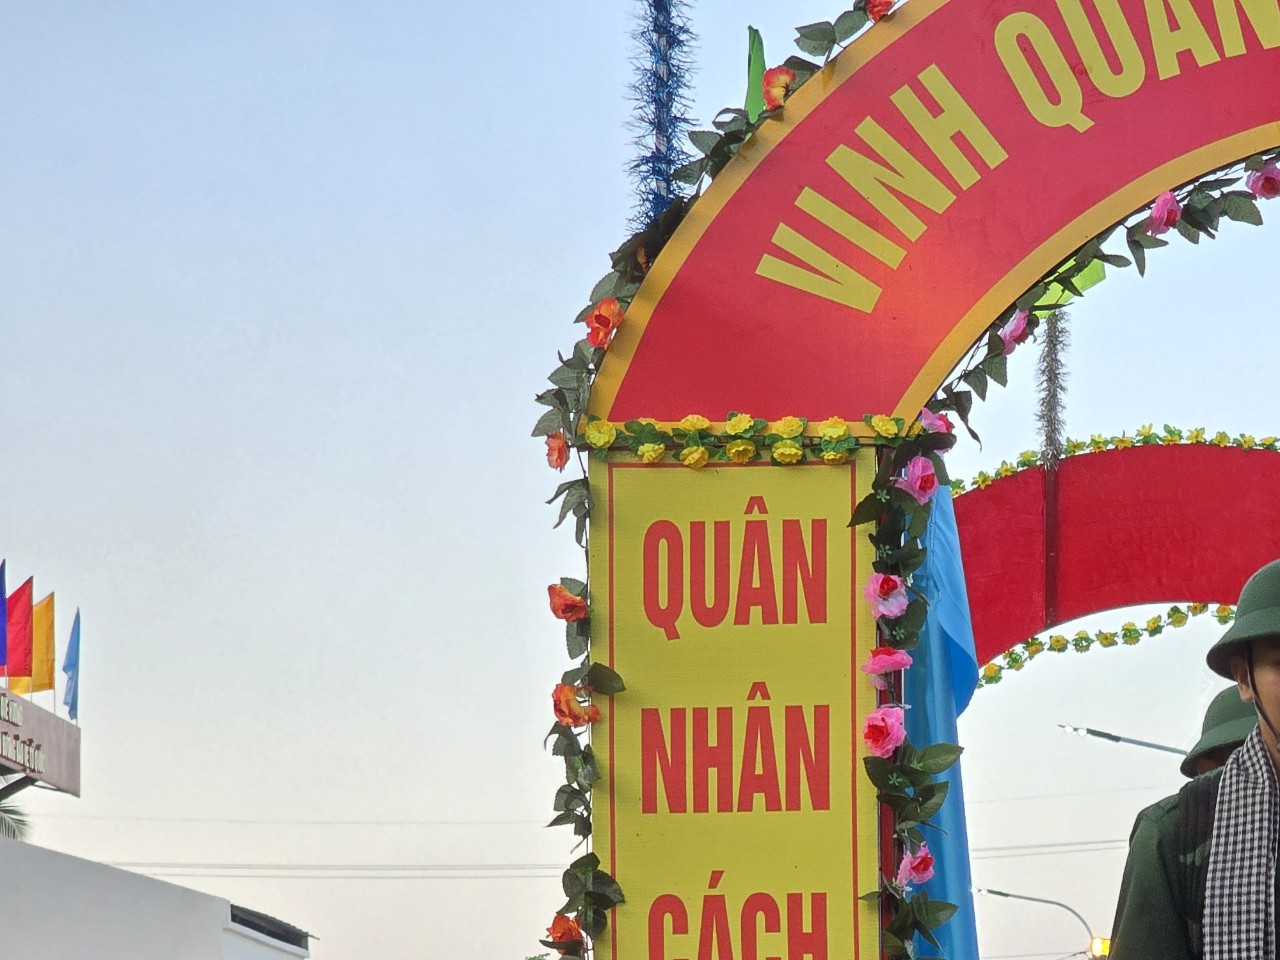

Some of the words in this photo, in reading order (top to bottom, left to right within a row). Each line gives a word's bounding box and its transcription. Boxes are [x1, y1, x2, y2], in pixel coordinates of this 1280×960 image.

[755, 63, 1009, 314] VINH
[644, 496, 828, 640] QUÂN
[641, 682, 830, 814] NHÂN
